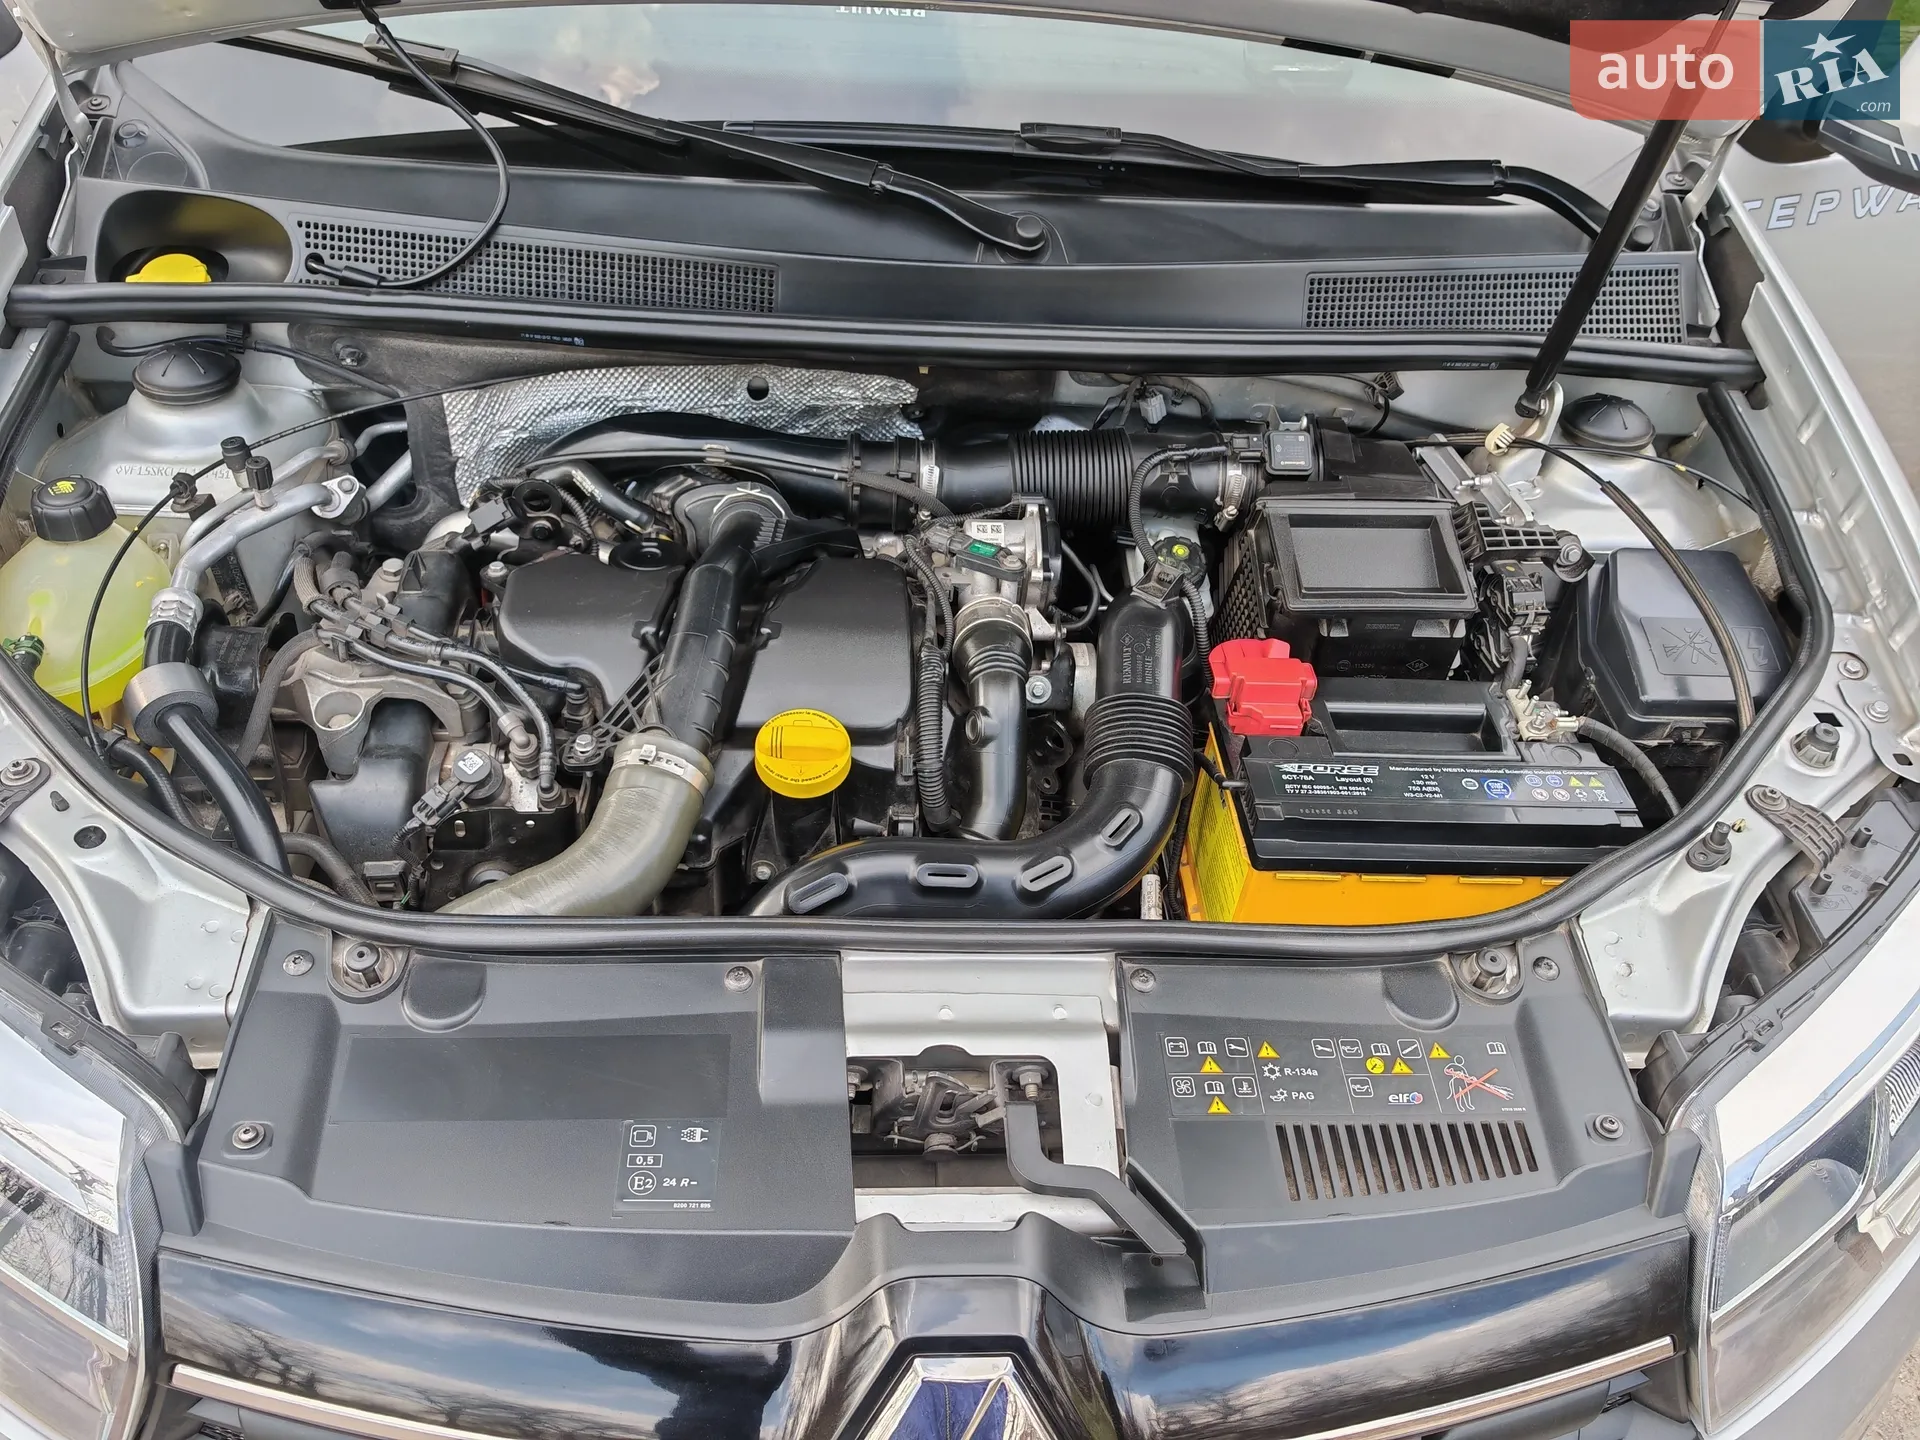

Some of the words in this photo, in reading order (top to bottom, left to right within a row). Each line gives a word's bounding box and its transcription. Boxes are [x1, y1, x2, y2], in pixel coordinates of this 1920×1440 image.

[1283, 1067, 1318, 1076] R-134a
[1291, 1091, 1315, 1101] PAG
[1388, 1092, 1411, 1103] elf
[635, 1156, 654, 1166] 0,5
[632, 1176, 653, 1190] E2
[662, 1177, 677, 1187] 24
